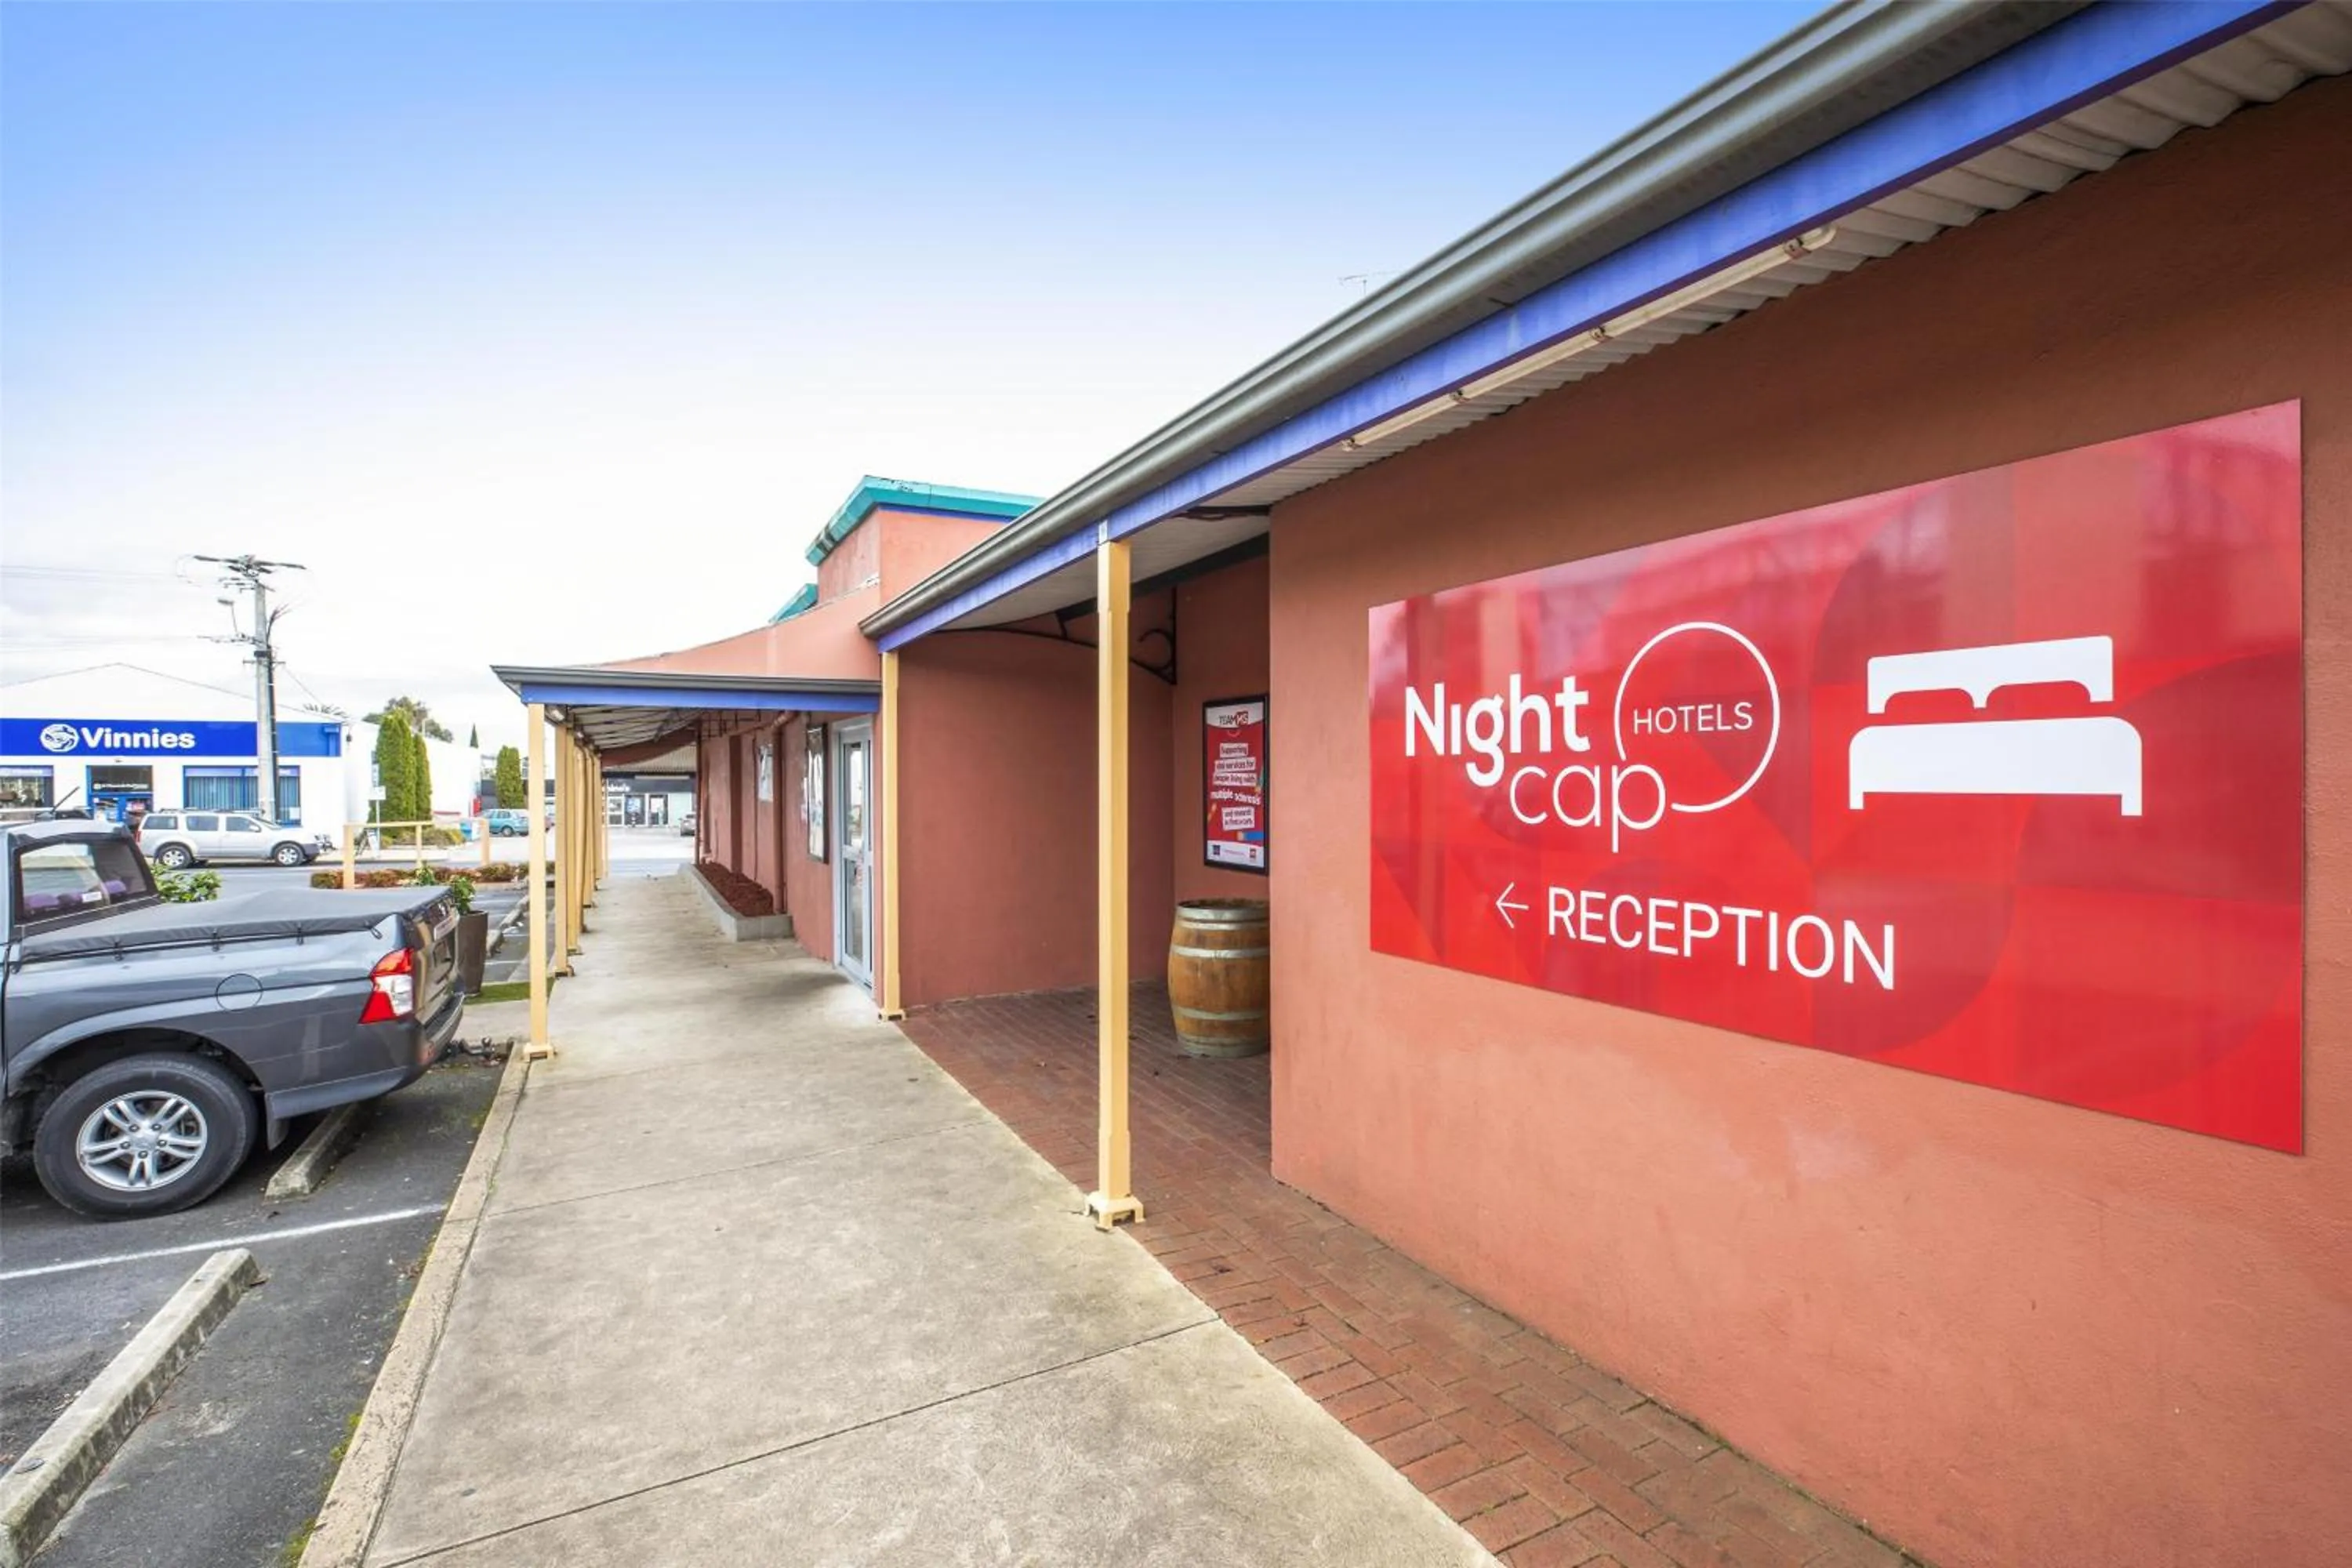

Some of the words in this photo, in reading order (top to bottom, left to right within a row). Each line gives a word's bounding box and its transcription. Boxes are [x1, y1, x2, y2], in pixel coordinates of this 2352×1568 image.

[81, 727, 195, 749] Vinnies
[1405, 673, 1591, 786] Night
[1633, 702, 1753, 735] HOTELS
[1509, 764, 1666, 853] cap
[1548, 886, 1894, 990] RECEPTION
